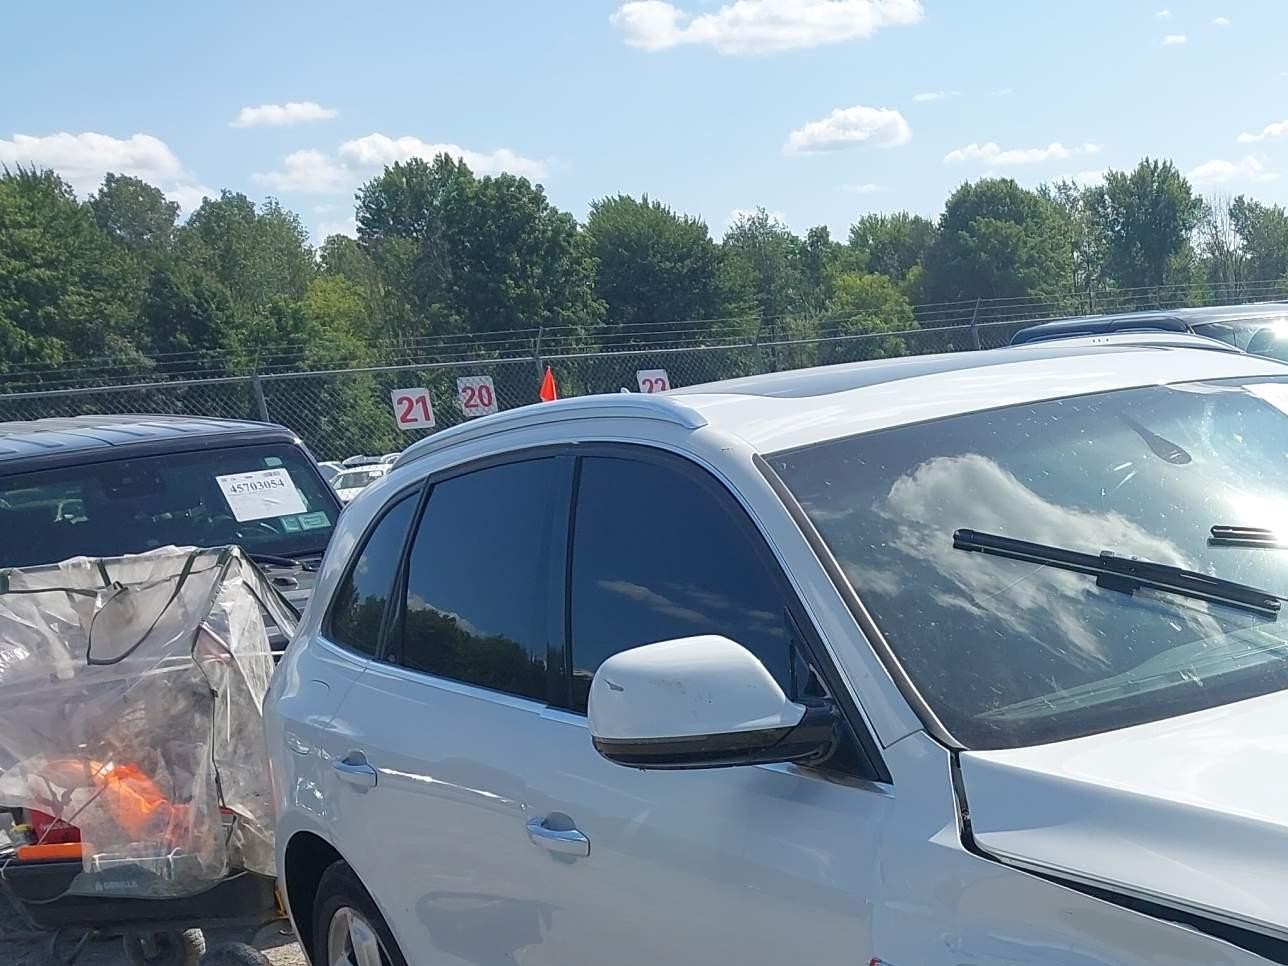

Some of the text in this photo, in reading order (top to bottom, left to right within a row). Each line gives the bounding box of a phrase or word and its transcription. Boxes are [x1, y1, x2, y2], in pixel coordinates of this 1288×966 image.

[462, 384, 493, 409] 20
[397, 395, 431, 424] 21
[230, 479, 285, 494] 45703054
